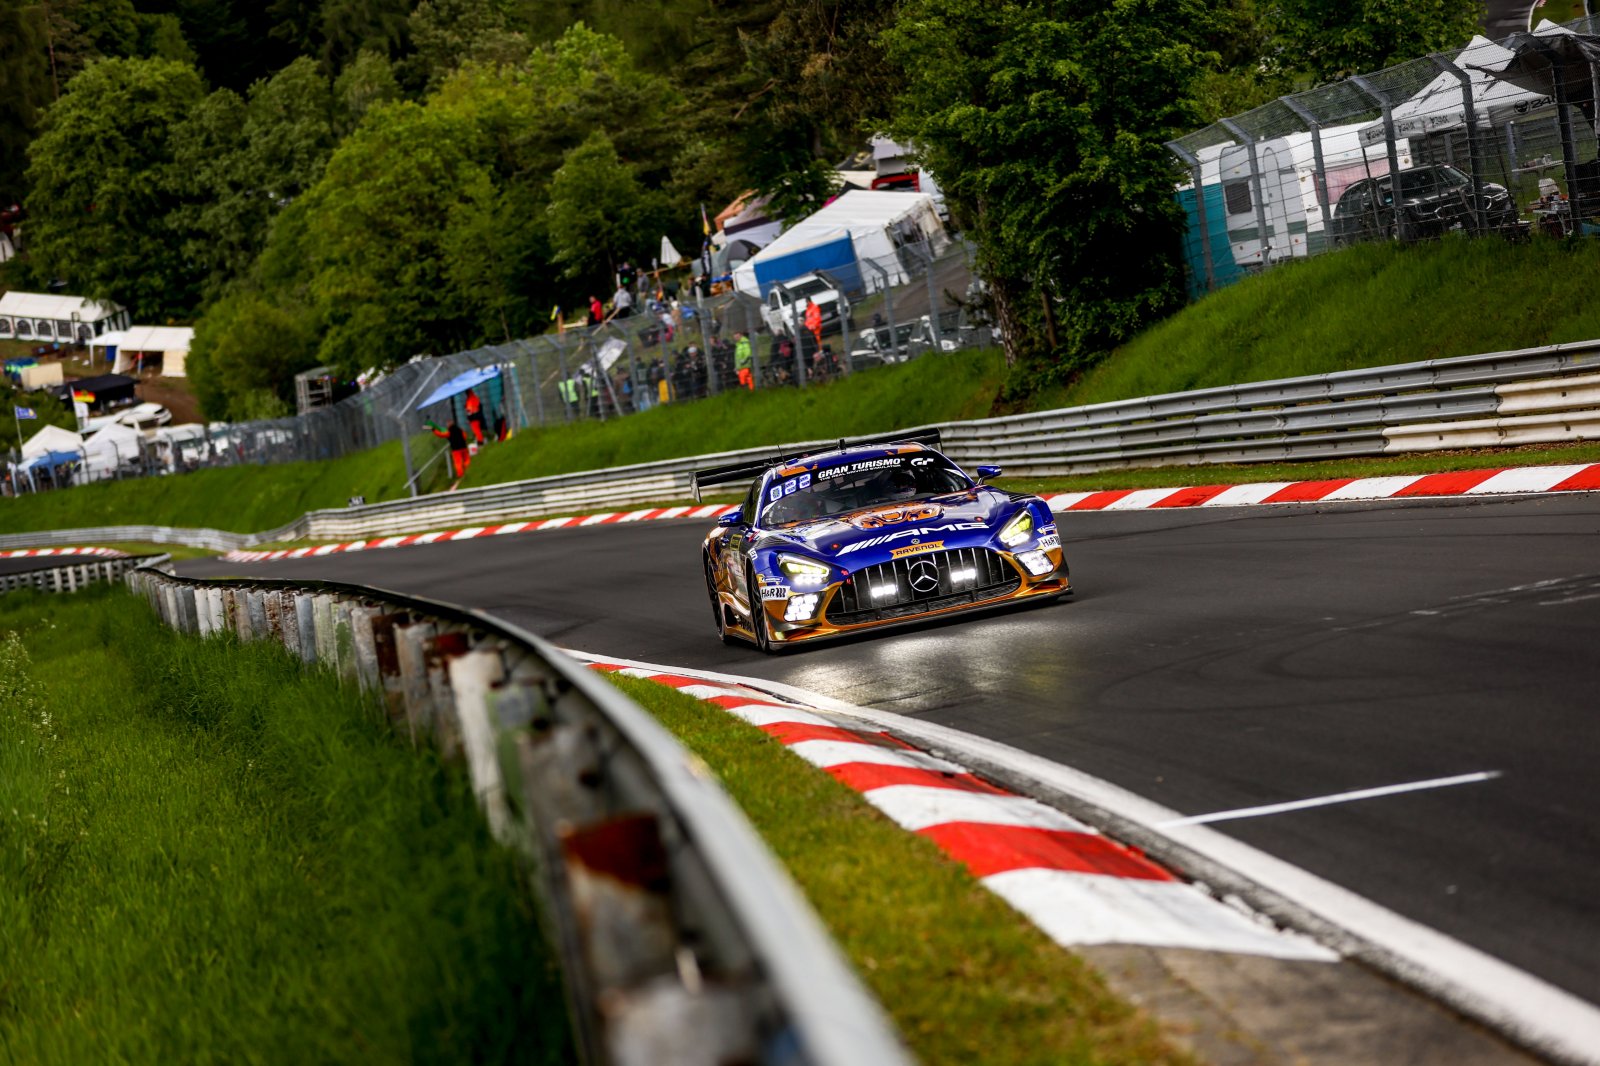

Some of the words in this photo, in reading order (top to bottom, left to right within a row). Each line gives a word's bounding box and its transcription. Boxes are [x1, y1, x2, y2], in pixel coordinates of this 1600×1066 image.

[817, 465, 849, 479] GRAN
[851, 458, 901, 471] TURISMO
[886, 522, 990, 542] AMG
[895, 543, 941, 556] RAVENOL
